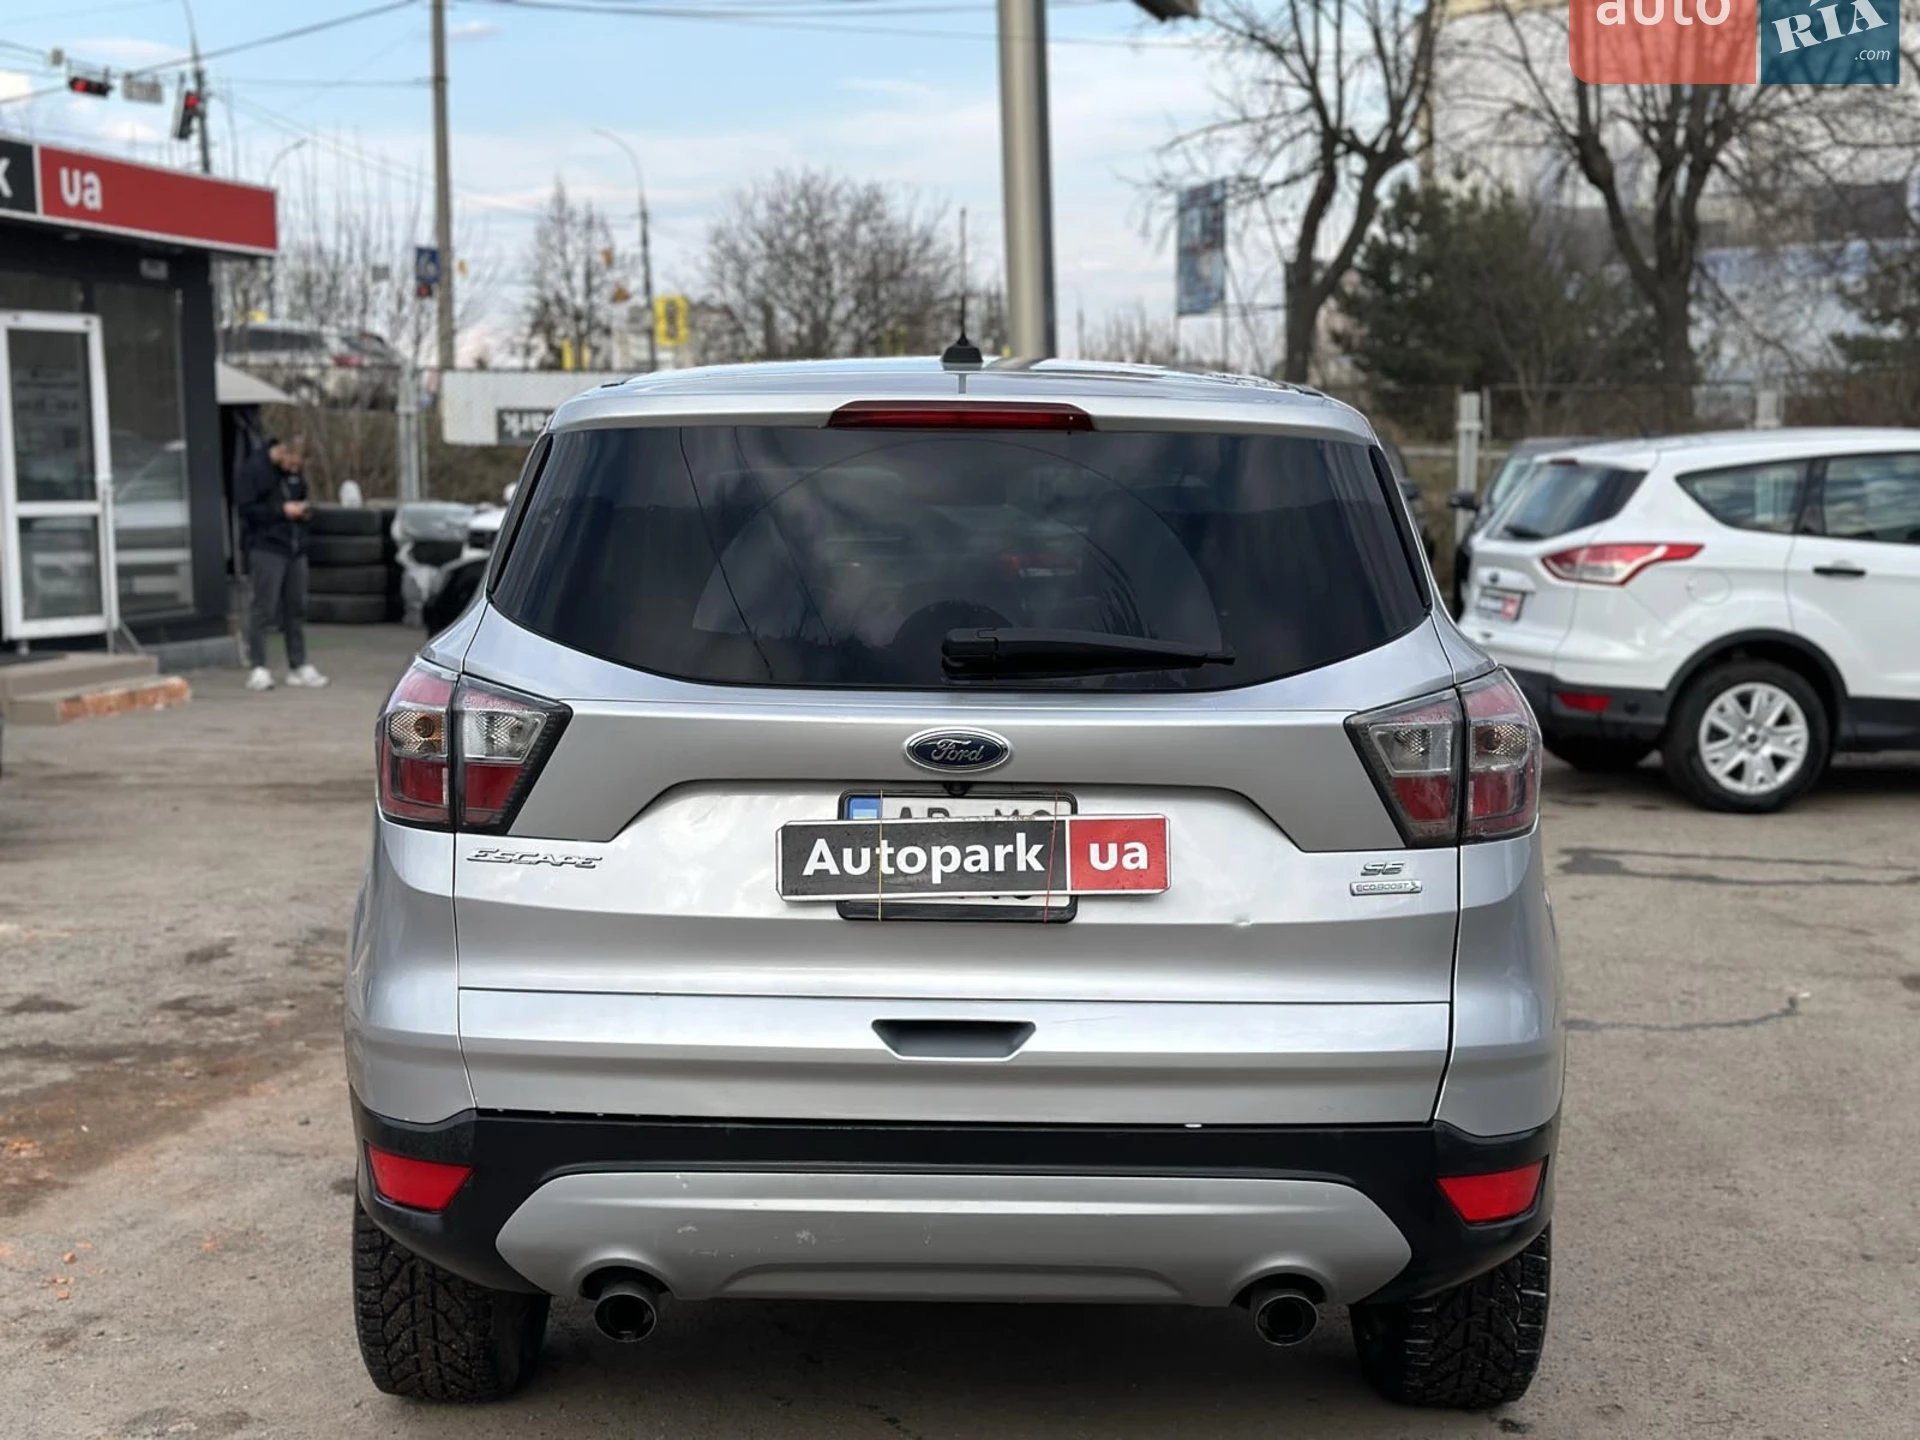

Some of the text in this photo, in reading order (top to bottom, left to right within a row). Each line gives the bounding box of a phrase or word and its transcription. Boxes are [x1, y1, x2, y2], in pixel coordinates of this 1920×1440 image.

[60, 167, 103, 211] ua
[930, 738, 985, 761] Ford
[466, 847, 603, 869] ESCAPE
[801, 832, 1148, 884] Autopark ua
[1361, 861, 1405, 876] SE
